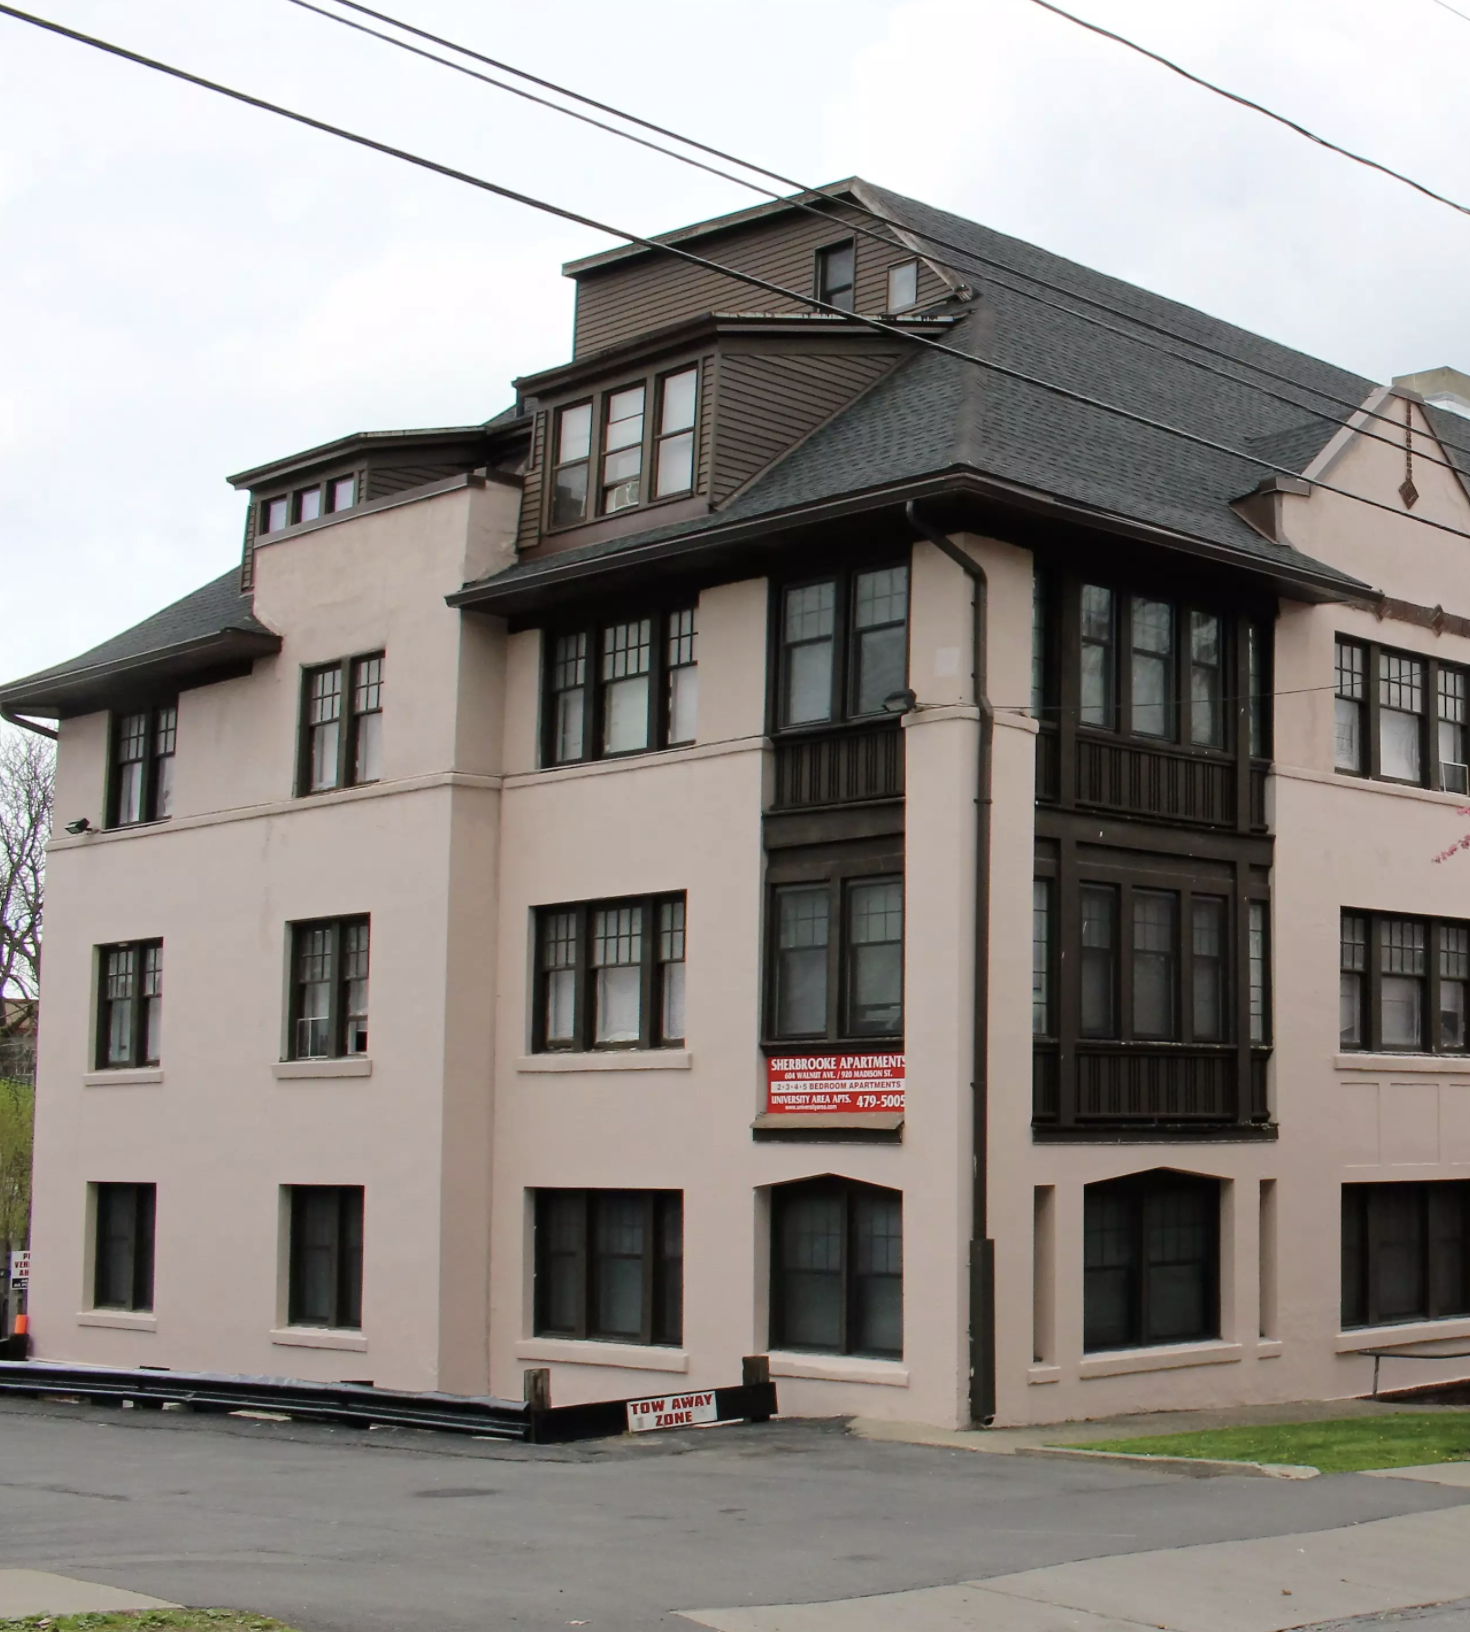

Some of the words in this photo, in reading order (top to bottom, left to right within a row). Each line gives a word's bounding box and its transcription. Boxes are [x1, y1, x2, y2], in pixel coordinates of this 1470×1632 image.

[771, 1057, 837, 1071] SHERBROOKE
[839, 1055, 906, 1069] APARTMENTS
[797, 1071, 821, 1080] WALNUT
[822, 1071, 836, 1079] AVE.
[853, 1070, 883, 1078] MADISON
[883, 1069, 893, 1077] ST.
[809, 1082, 847, 1090] BEDROOM
[849, 1081, 902, 1089] APARTMENTS
[771, 1095, 810, 1104] UNIVERSITY
[811, 1095, 831, 1104] AREA
[832, 1094, 852, 1103] APTS.
[856, 1094, 906, 1108] 479-5005
[630, 1399, 665, 1415] TOW
[672, 1394, 713, 1410] AWAY
[655, 1411, 693, 1427] ZONE
